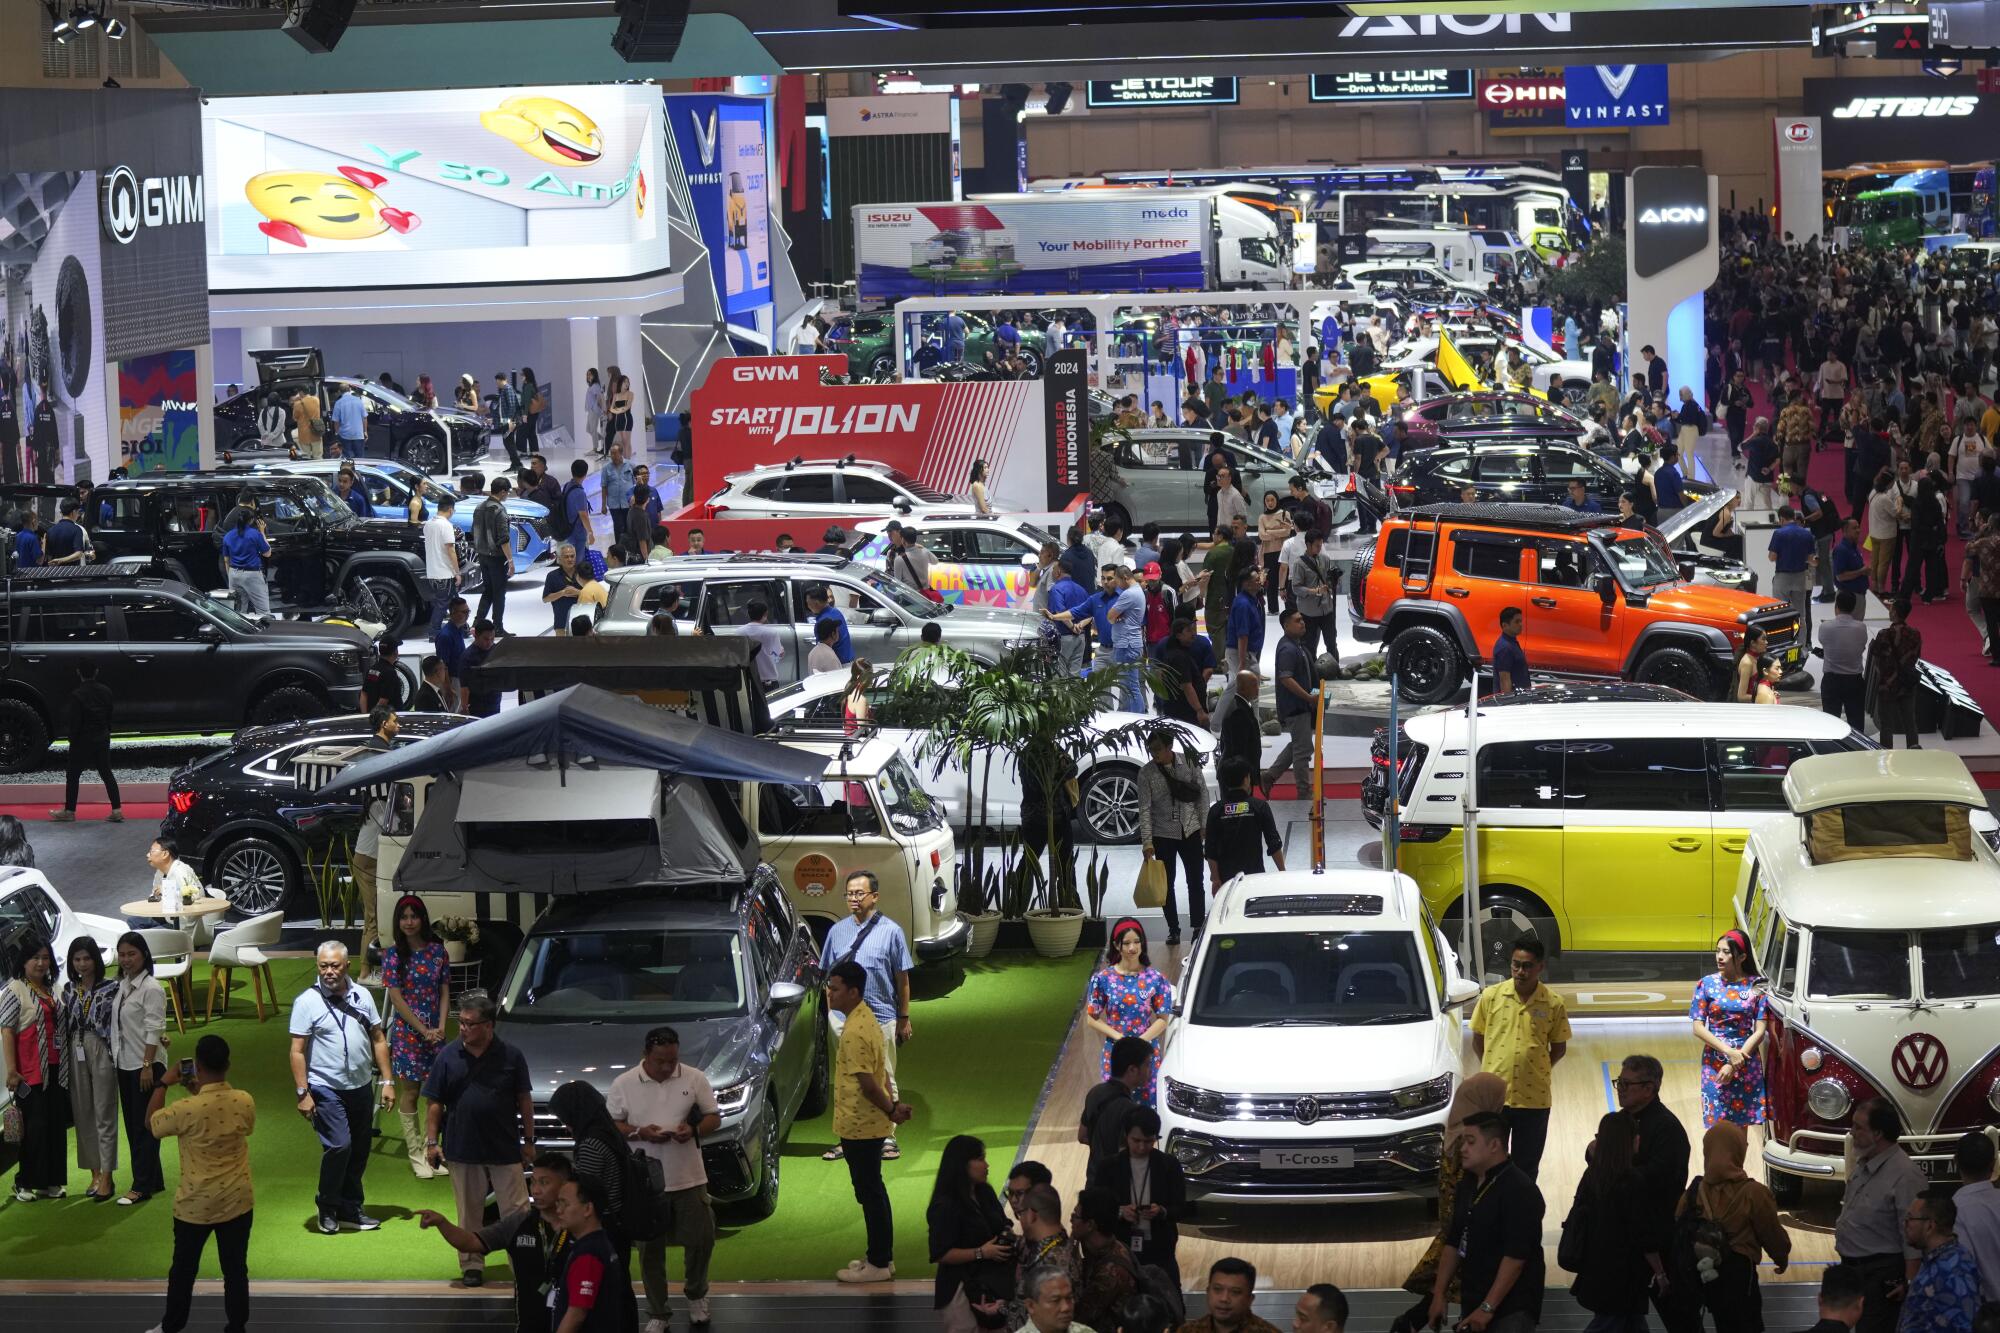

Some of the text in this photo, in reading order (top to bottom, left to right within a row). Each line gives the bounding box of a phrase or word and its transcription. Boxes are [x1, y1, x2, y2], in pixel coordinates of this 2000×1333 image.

[1111, 76, 1214, 90] JETOUR
[1348, 83, 1436, 93] Drive Your Future
[1122, 90, 1202, 100] Drive Your Future
[1515, 85, 1567, 101] HIN
[1570, 104, 1665, 120] VINFAST
[1832, 95, 1980, 119] JETBUS
[142, 175, 204, 228] GWM
[867, 213, 912, 222] ISUZU
[1638, 206, 1706, 223] AION
[1038, 237, 1189, 252] Your Mobility Partner
[733, 365, 799, 382] GWM
[1054, 362, 1079, 375] 2024
[710, 403, 921, 446] START JOLION
[748, 425, 774, 435] WITH
[1055, 401, 1068, 486] ASSEMBLED
[1066, 388, 1078, 485] IN INDONESIA
[1275, 1153, 1339, 1165] T-Cross
